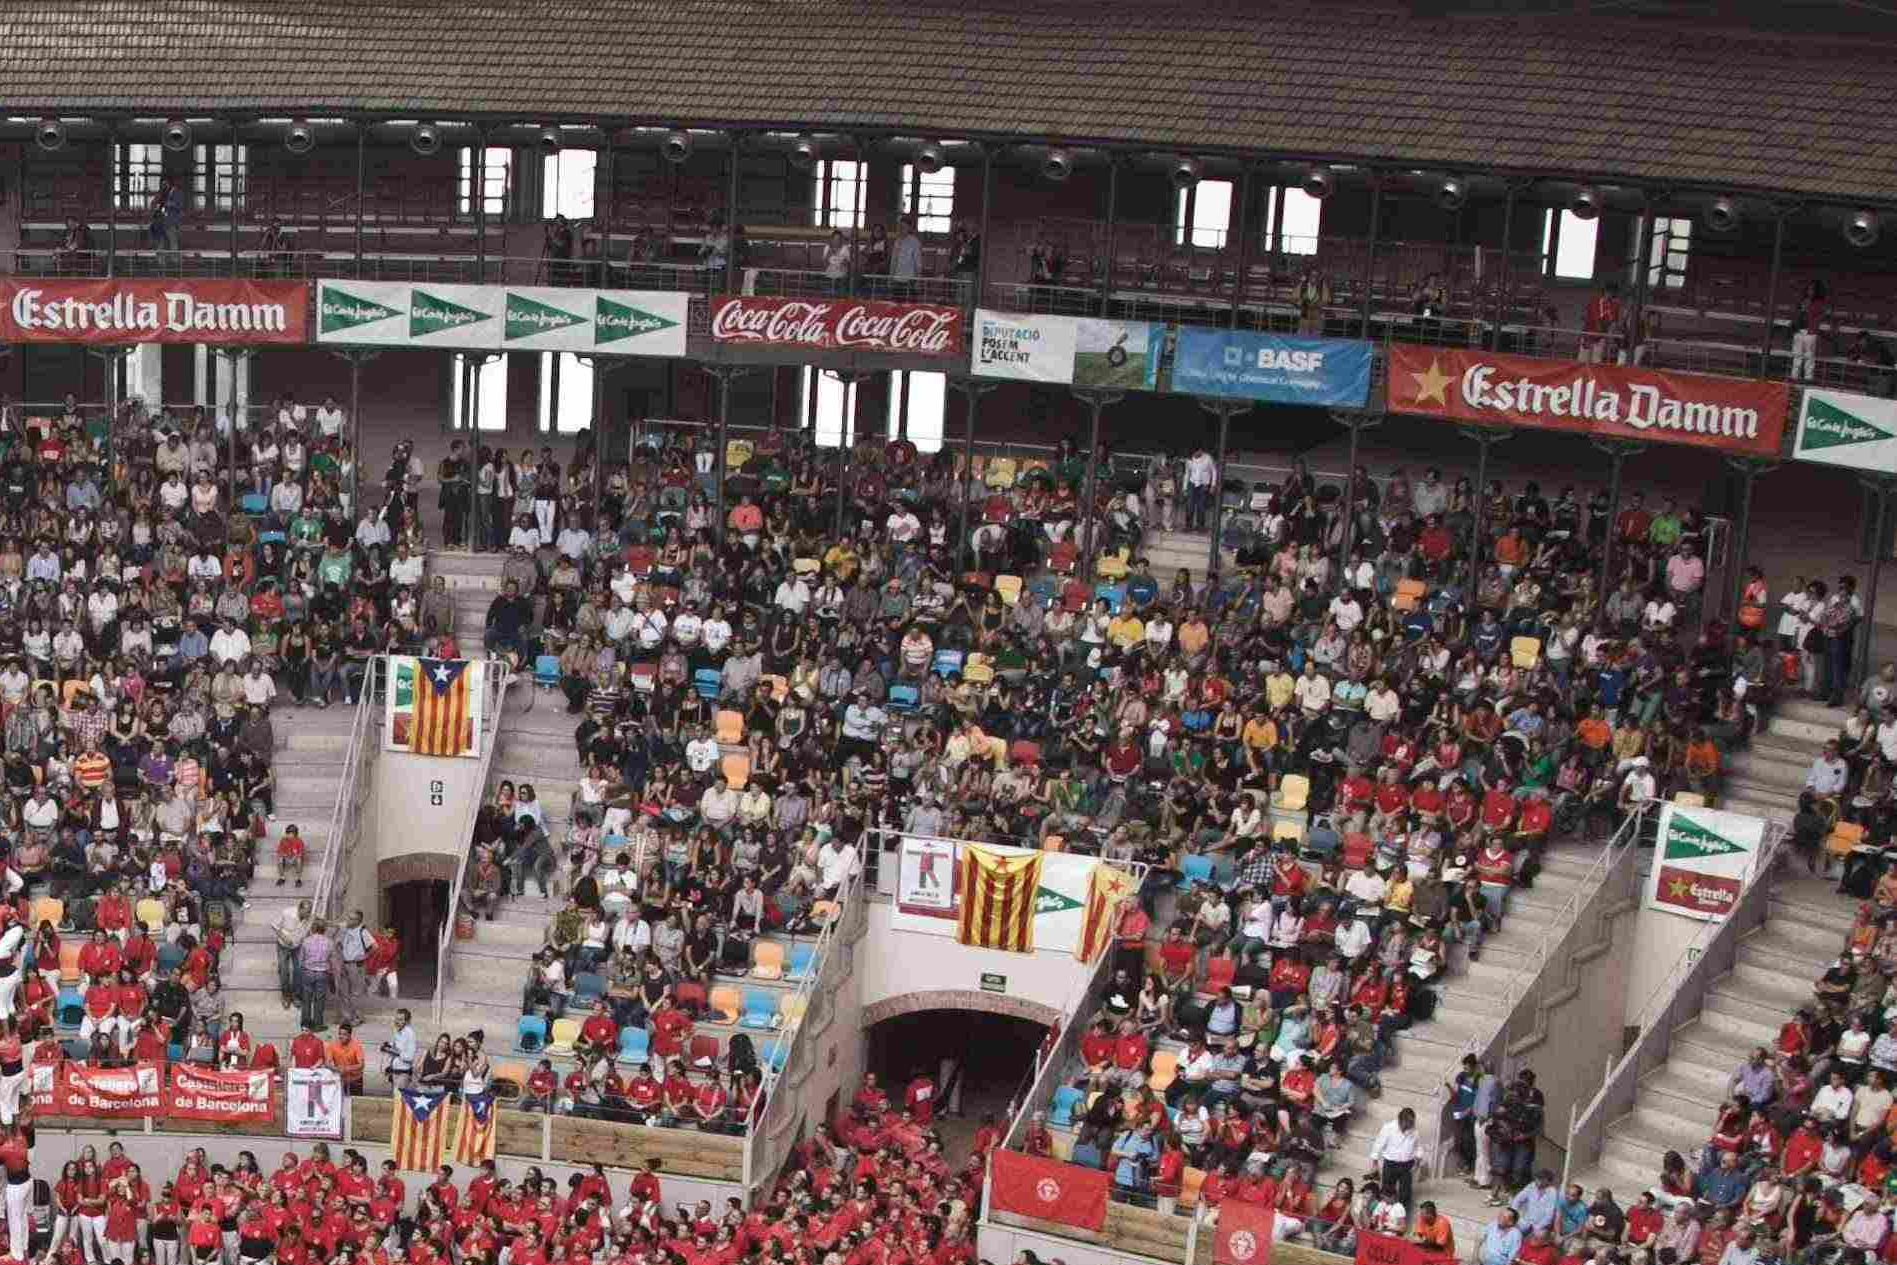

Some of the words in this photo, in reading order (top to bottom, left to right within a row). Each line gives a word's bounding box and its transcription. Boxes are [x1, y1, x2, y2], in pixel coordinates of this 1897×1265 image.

[12, 286, 160, 330] Estrella
[163, 291, 286, 332] Damm
[1257, 349, 1324, 371] BASF
[1461, 362, 1619, 422] Estrella
[1624, 383, 1759, 439] Damm
[1690, 881, 1734, 904] Estrella
[68, 1093, 87, 1105] de
[88, 1094, 160, 1109] Barcelona
[174, 1095, 193, 1108] de
[195, 1097, 268, 1113] Barcelona
